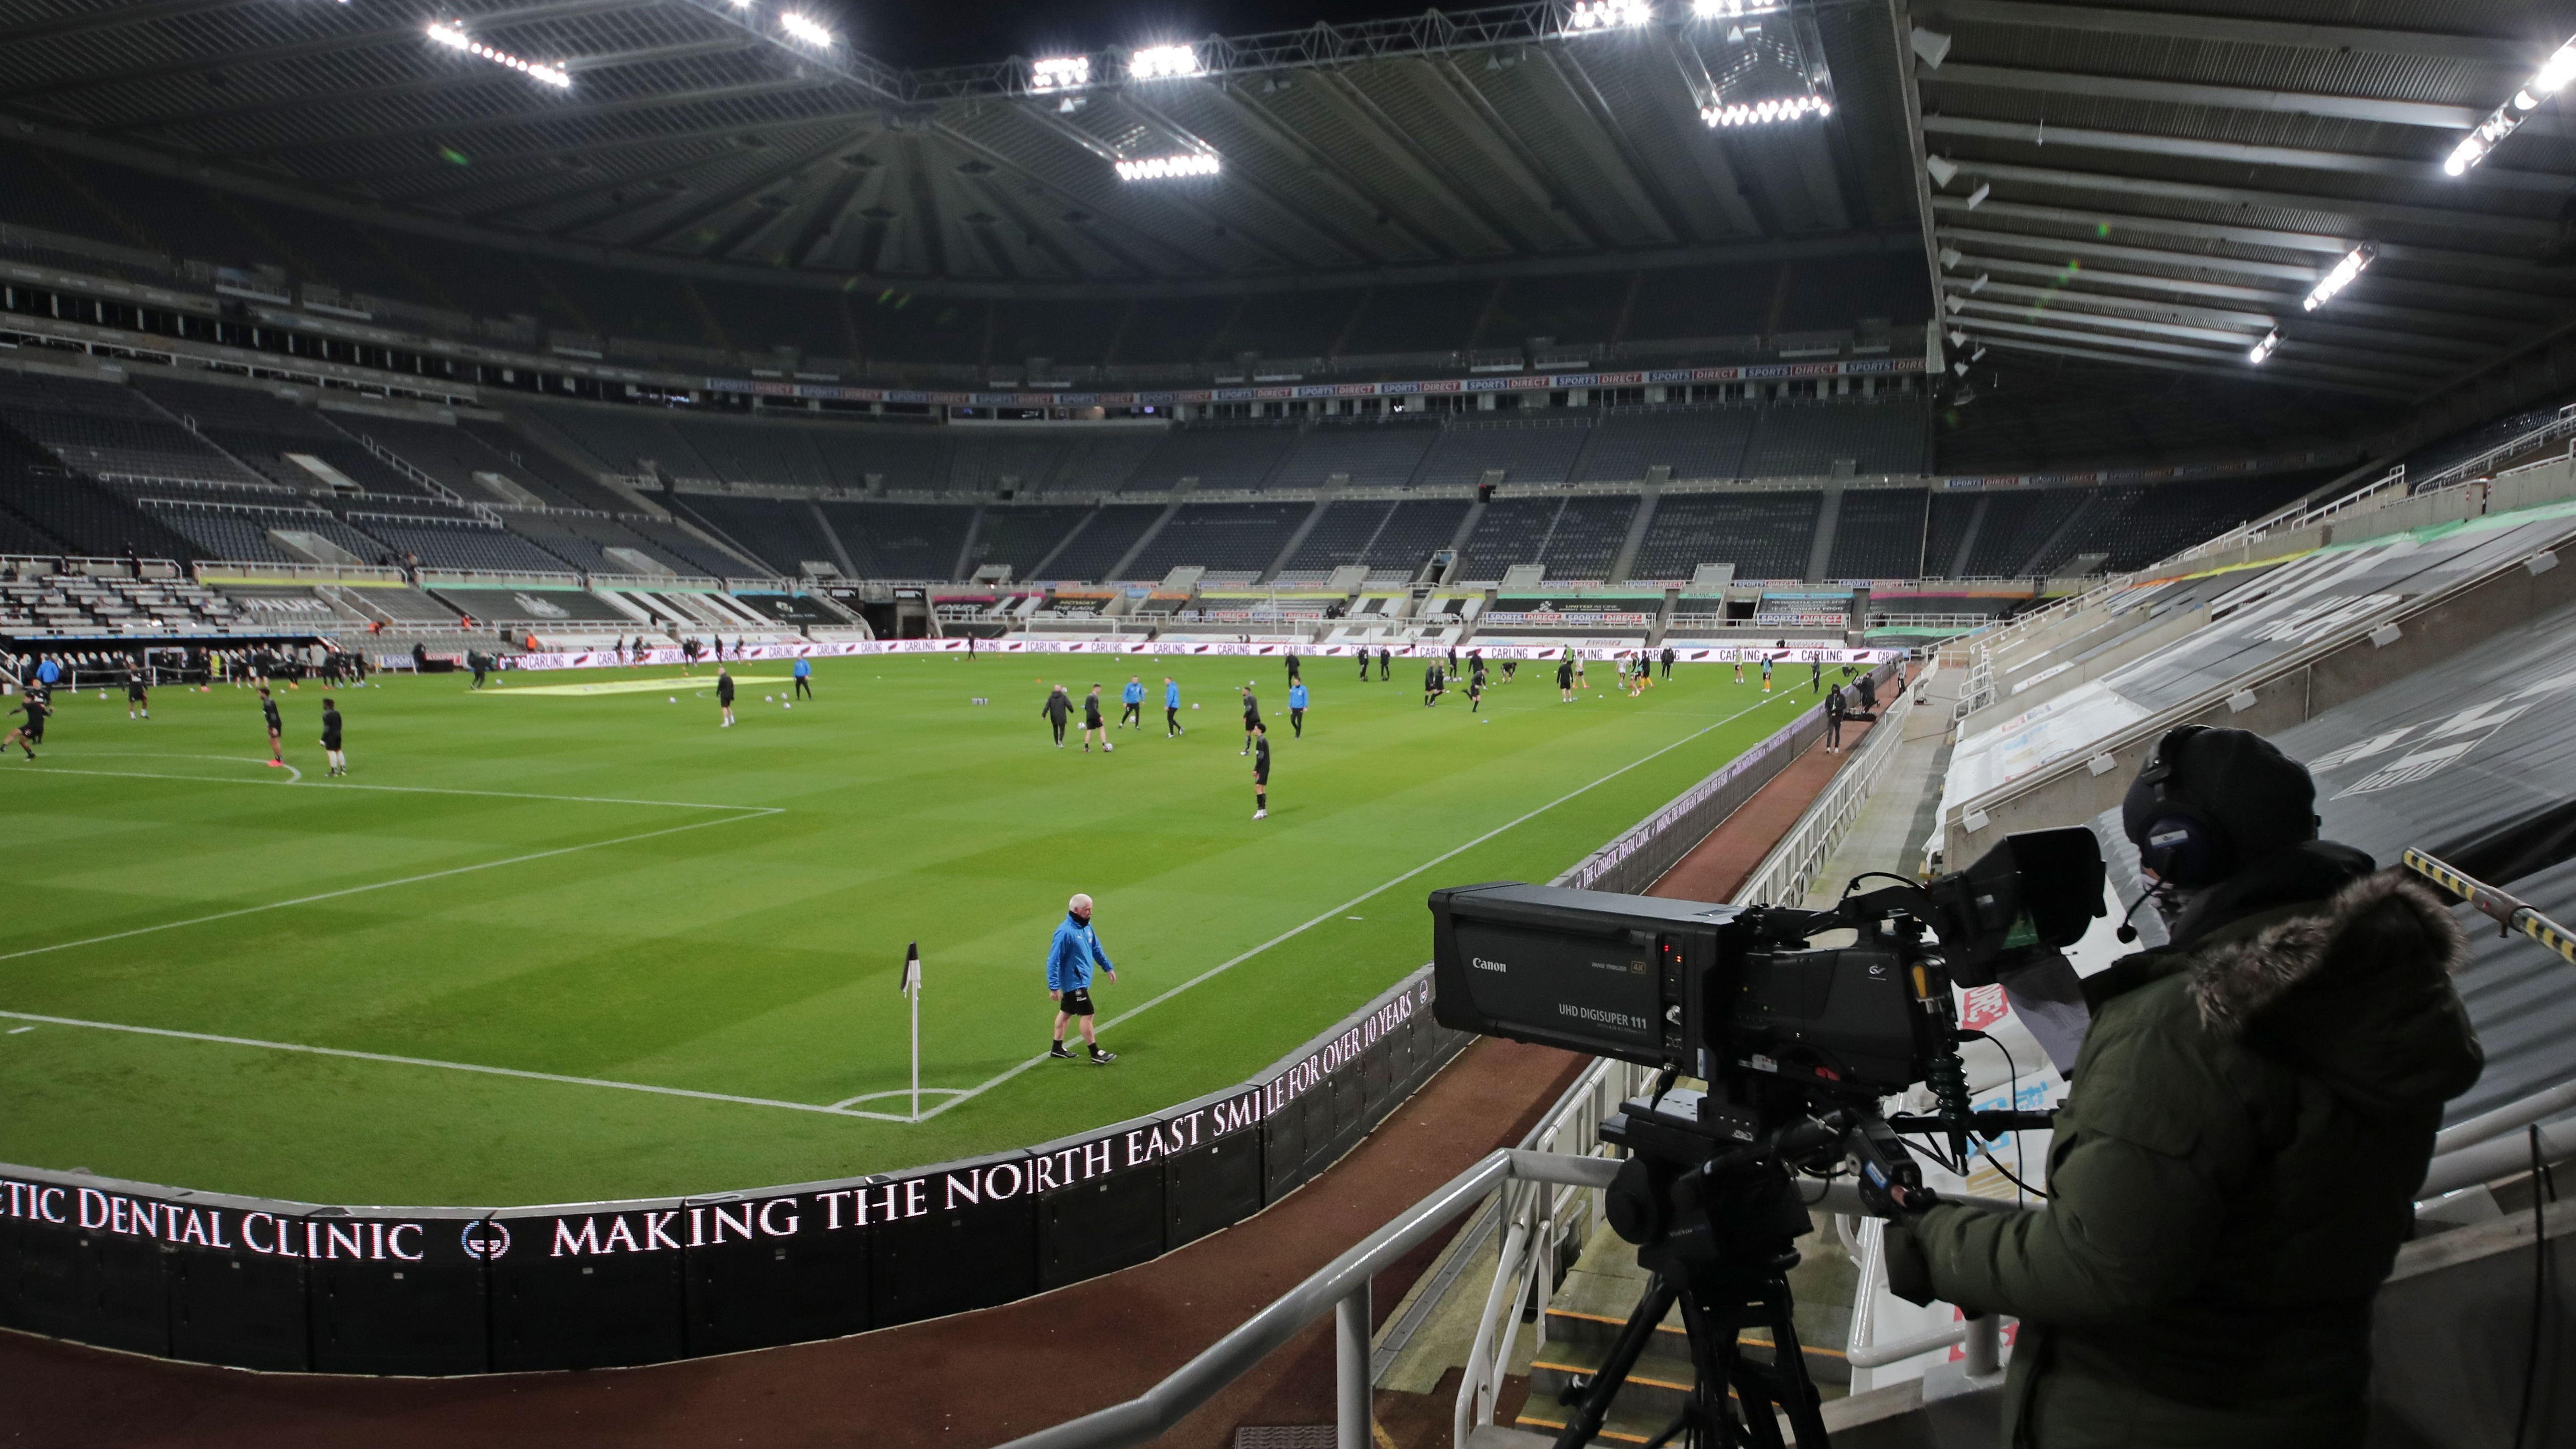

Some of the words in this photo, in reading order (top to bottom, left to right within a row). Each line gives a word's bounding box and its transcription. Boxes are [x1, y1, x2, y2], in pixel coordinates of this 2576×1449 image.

[1748, 367, 1787, 376] SPORTS
[1795, 365, 1834, 374] DIRECT
[1850, 361, 1890, 370] SPORTS
[1559, 376, 1595, 385] SPORTS
[1602, 374, 1638, 383] DIRECT
[1651, 372, 1690, 381] SPORTS
[1695, 370, 1732, 379] DIRECT
[1383, 384, 1419, 393] SPORTS
[1423, 382, 1458, 391] DIRECT
[1469, 380, 1506, 389] SPORTS
[1511, 378, 1547, 387] DIRECT
[1607, 614, 1639, 622] DIRECT
[770, 645, 794, 657] CARLING
[817, 642, 840, 654] CARLING
[862, 642, 882, 652] CARLING
[905, 641, 936, 651] CARLING
[975, 641, 1001, 651] ARLING
[1031, 642, 1060, 652] CARLING
[1092, 643, 1122, 652] CARLING
[1154, 644, 1185, 654] CARLING
[1218, 645, 1250, 655] CARLING
[1351, 646, 1382, 656] CAIN
[660, 649, 685, 662] CARLIN
[1421, 647, 1450, 657] CARLIN
[1492, 648, 1528, 659] CARLING
[1572, 649, 1602, 659] ALING
[1720, 650, 1760, 660] CAING
[529, 654, 564, 668] CARLING
[598, 652, 629, 665] CARLG
[1583, 866, 1595, 887] THE
[1595, 848, 1618, 878] COSMETIC
[1619, 839, 1635, 861] DENTAL
[1636, 826, 1650, 847] CLINIC
[1472, 958, 1507, 973] Canon
[1559, 1003, 1578, 1017] UHD
[1581, 1007, 1629, 1027] DIGISUPER
[1630, 1016, 1647, 1030] 111
[77, 1185, 231, 1249] DENTAL
[241, 1212, 424, 1260] CLINIC
[550, 1197, 800, 1257] MAKING
[815, 1178, 929, 1230] THE
[943, 1138, 1112, 1211] NORTH
[1126, 1110, 1205, 1168] EAST
[1212, 1077, 1285, 1137] SMILE
[1288, 1054, 1321, 1100] FOR
[1322, 1026, 1362, 1074] OVER
[1364, 1015, 1377, 1048] 10
[1379, 990, 1413, 1035] YEARS
